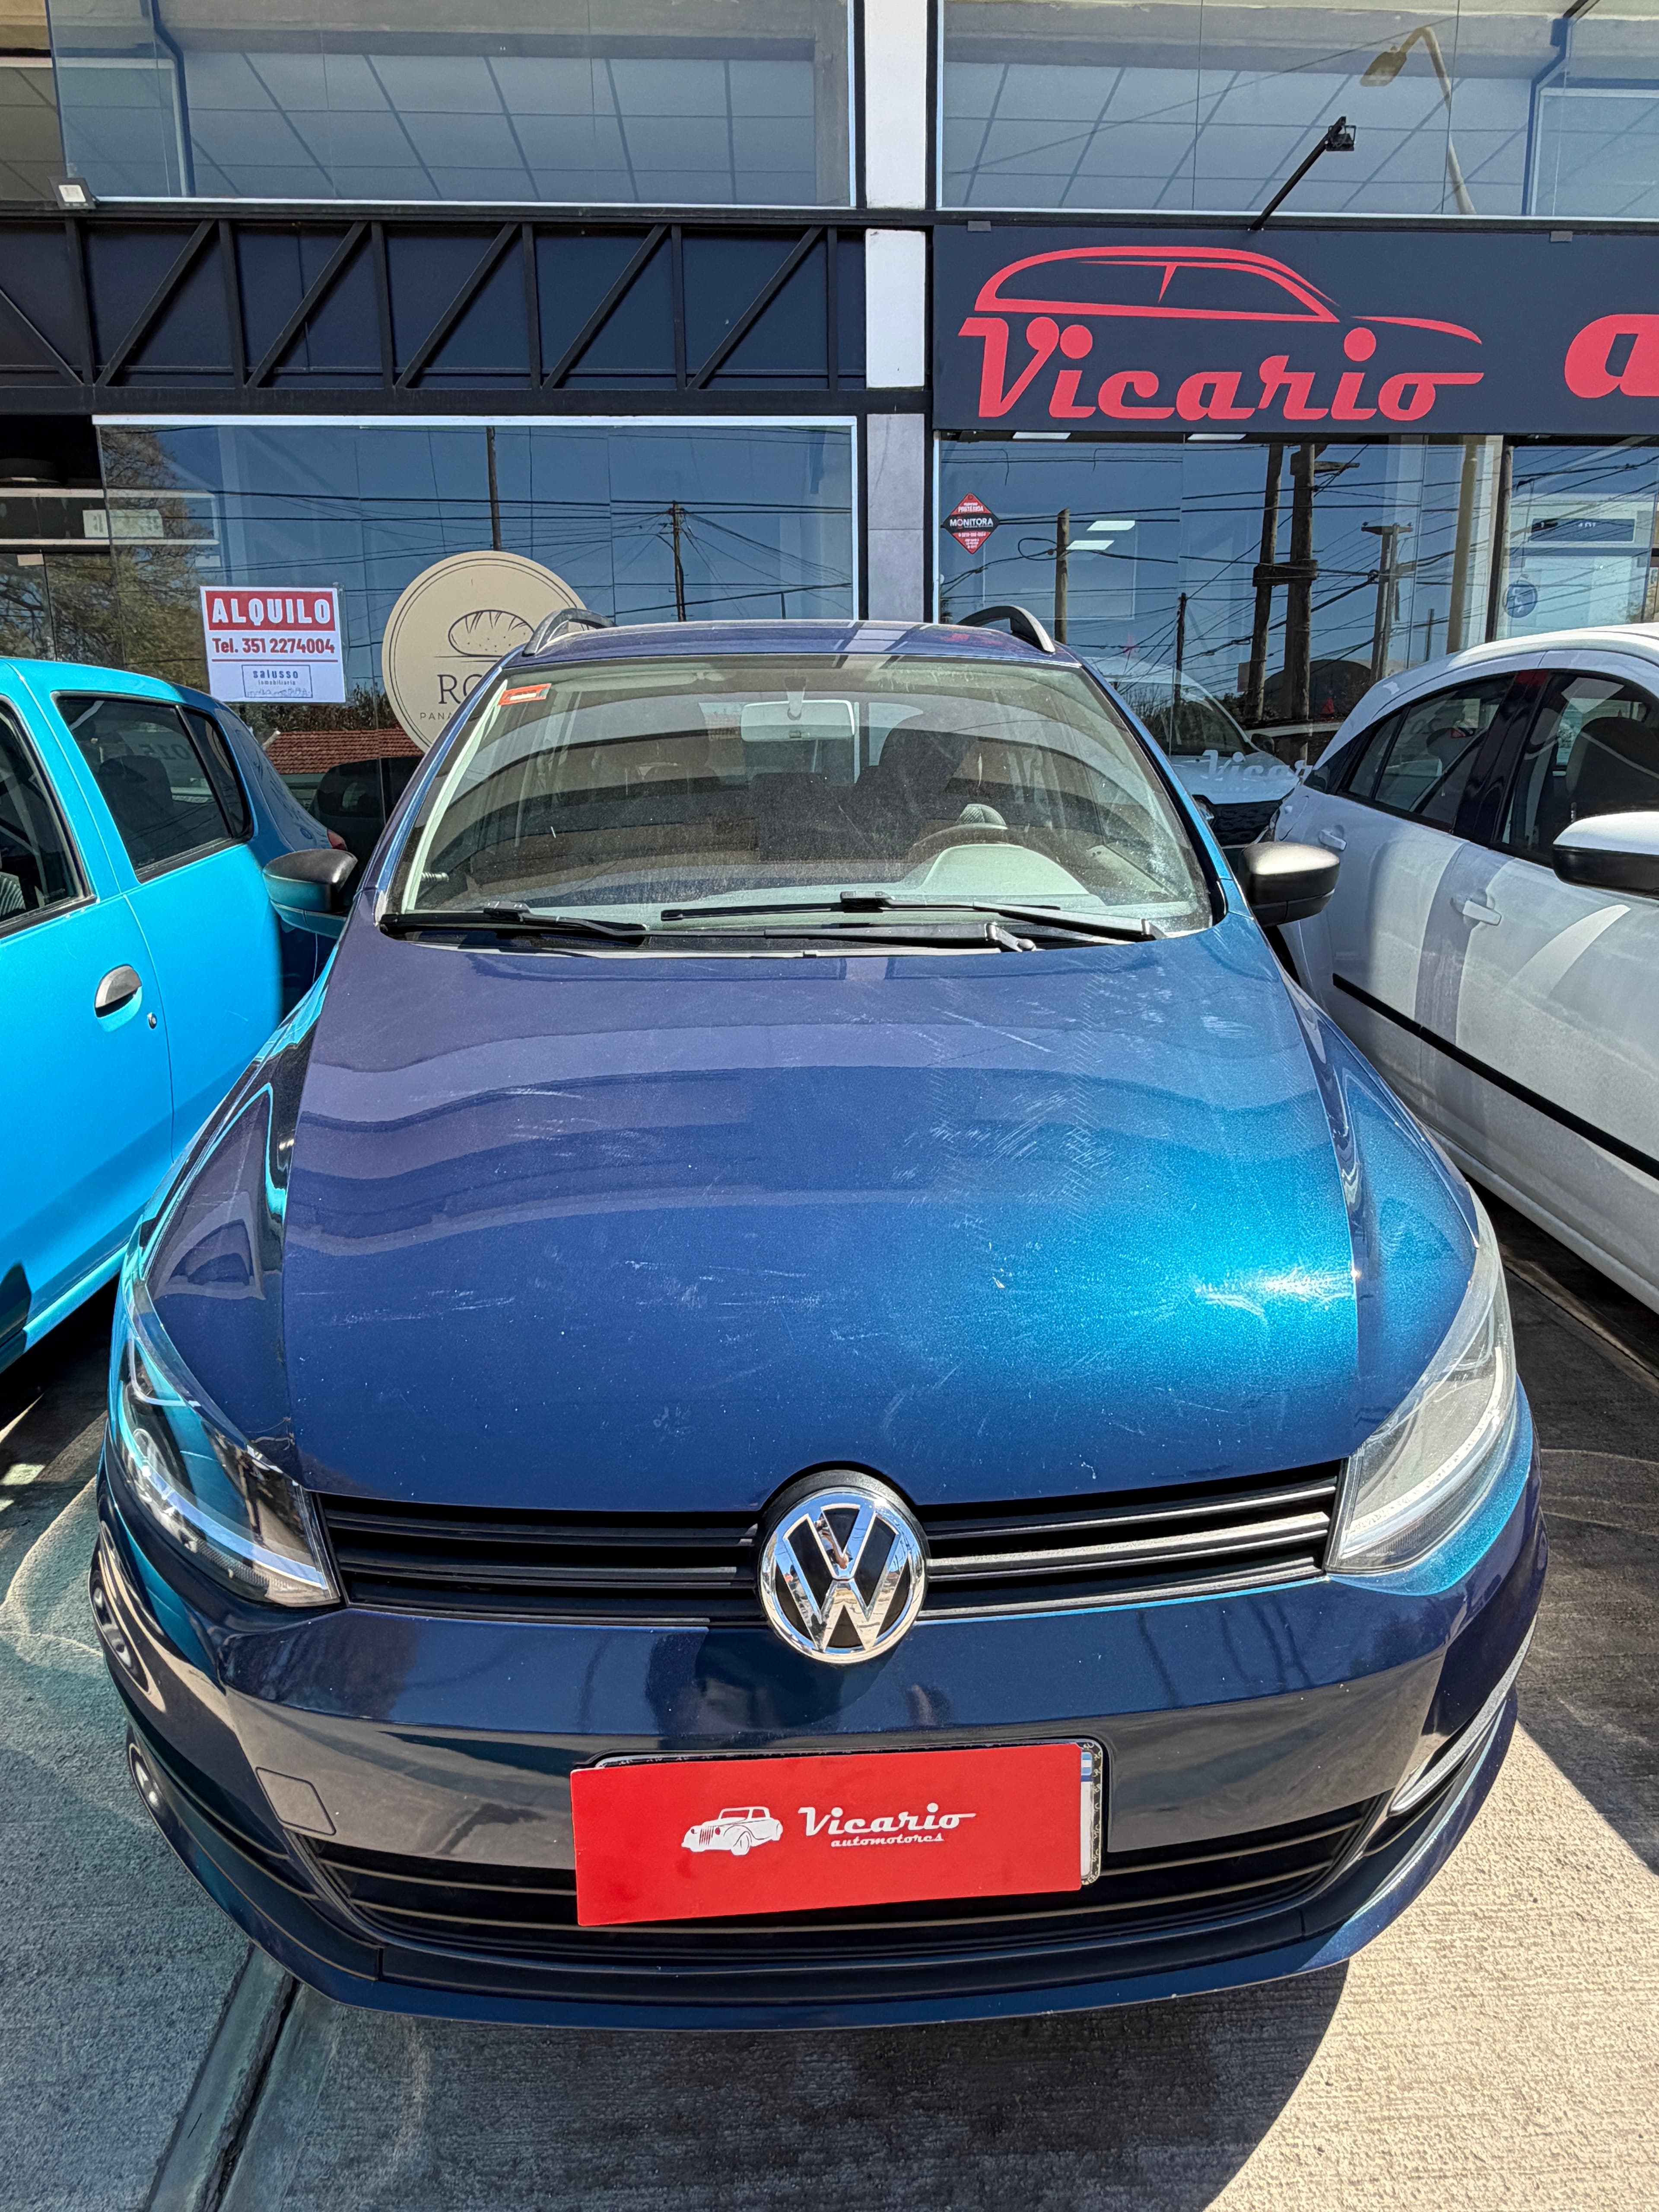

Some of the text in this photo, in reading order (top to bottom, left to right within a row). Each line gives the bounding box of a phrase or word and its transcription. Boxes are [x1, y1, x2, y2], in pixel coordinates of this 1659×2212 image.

[958, 317, 1484, 421] Vicario
[950, 518, 993, 527] MONITORA
[212, 598, 331, 626] ALQUILO
[212, 638, 335, 654] Tel. 351 2274004
[253, 670, 299, 679] salusso
[798, 1802, 976, 1836] Vicario
[831, 1833, 944, 1847] automotores
